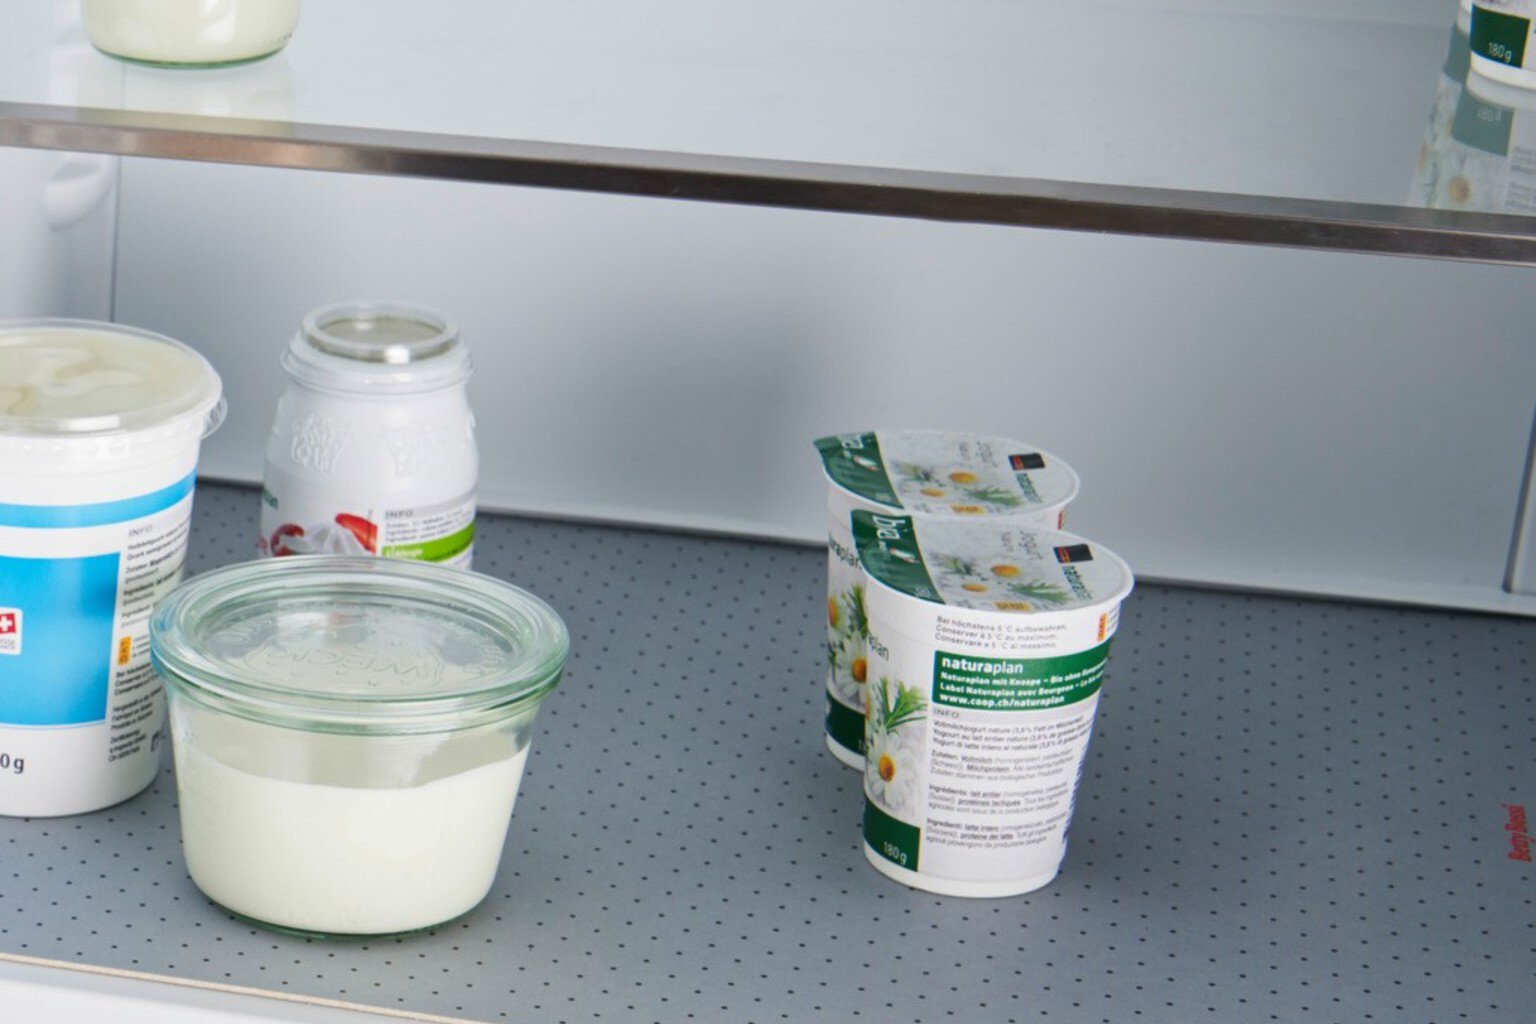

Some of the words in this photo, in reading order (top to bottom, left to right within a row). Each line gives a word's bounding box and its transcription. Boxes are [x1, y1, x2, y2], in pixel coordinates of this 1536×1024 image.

[936, 625, 978, 638] Conserver
[937, 616, 949, 625] Bei
[951, 619, 995, 632] höchstens
[935, 633, 982, 647] Conservare
[942, 657, 1024, 675] naturaplan
[941, 672, 990, 686] Naturaplan
[1009, 678, 1040, 687] Knospe
[940, 682, 964, 693] Label
[966, 687, 1015, 697] Naturaplan
[940, 693, 1065, 708] www.coop.ch/naturaplan
[934, 709, 959, 718] INFO
[14, 757, 25, 774] g
[900, 853, 907, 865] g
